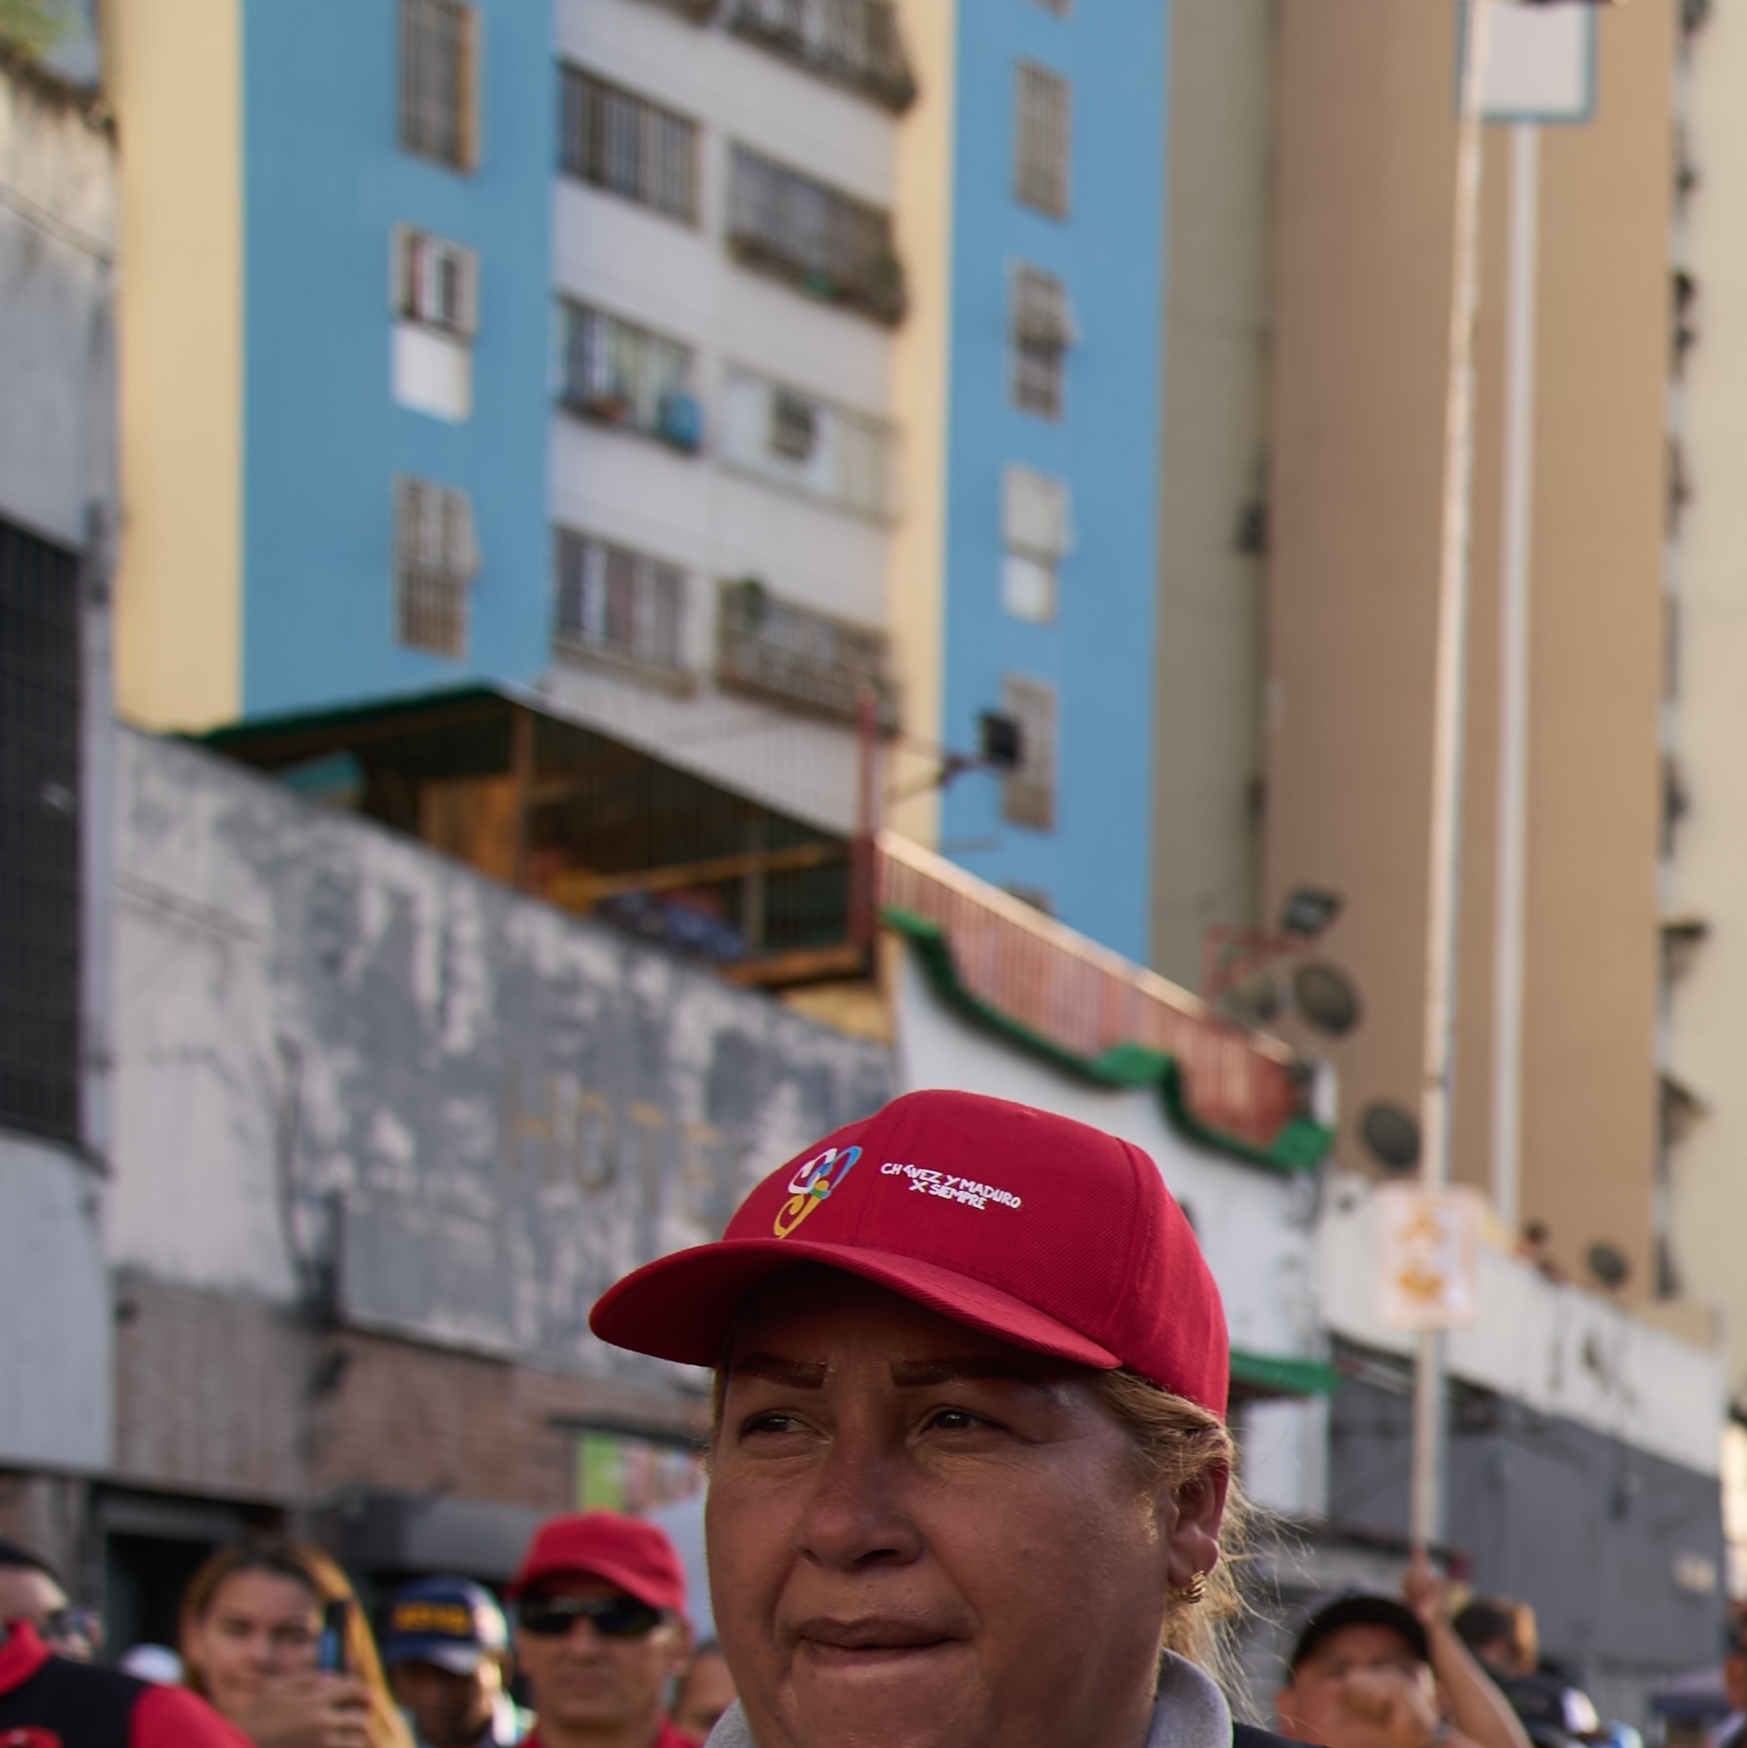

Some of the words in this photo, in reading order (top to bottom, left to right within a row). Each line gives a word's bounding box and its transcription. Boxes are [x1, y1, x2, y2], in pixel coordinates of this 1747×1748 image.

[908, 1180, 929, 1193] X
[928, 1184, 987, 1210] SIEMPRE
[943, 1175, 961, 1187] Y
[959, 1178, 1022, 1209] MADURO
